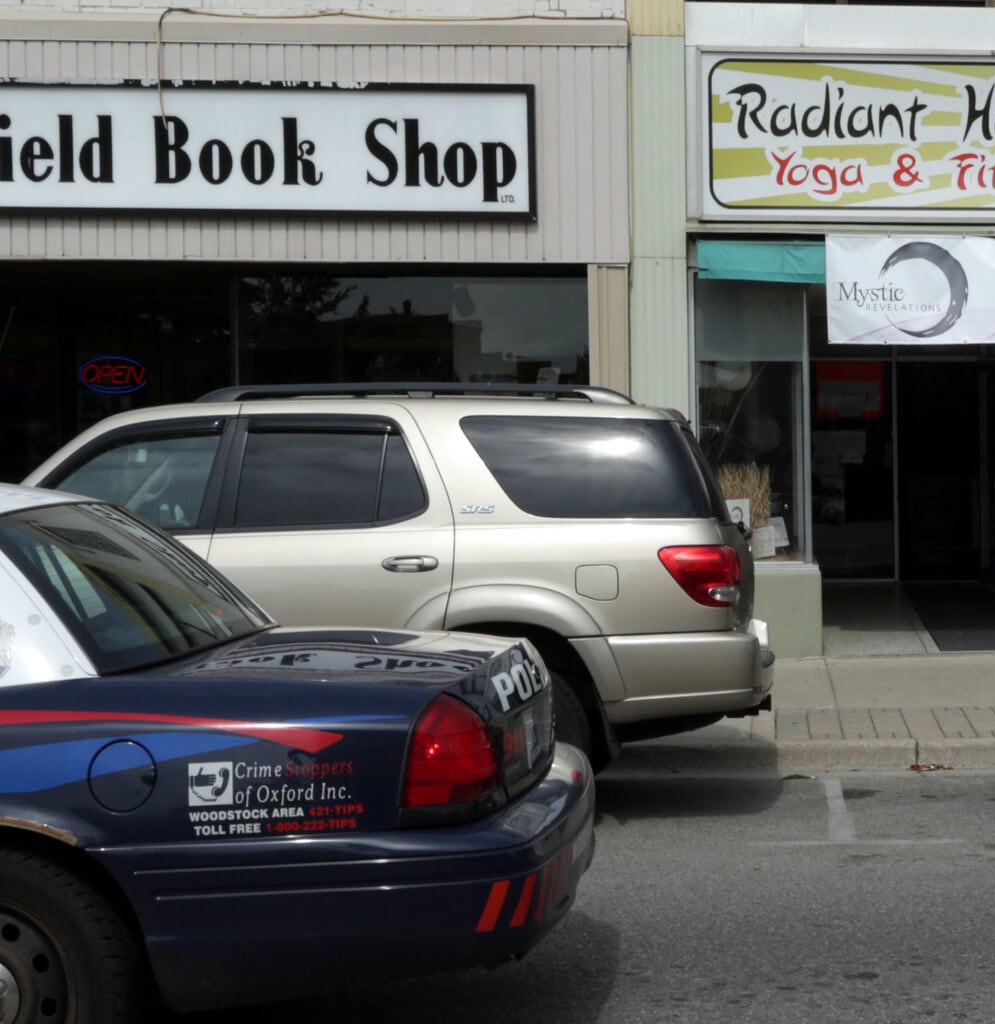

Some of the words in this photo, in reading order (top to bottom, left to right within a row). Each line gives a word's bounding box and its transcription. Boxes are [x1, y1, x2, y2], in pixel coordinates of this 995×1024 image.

[727, 84, 928, 140] Radiant
[152, 115, 324, 186] Book
[364, 117, 517, 203] Shop
[771, 150, 863, 195] Yoga
[892, 153, 924, 186] &
[838, 281, 904, 306] Mystic
[865, 302, 941, 313] REVELATIONS
[81, 363, 147, 386] OPEN
[234, 762, 283, 779] Crime
[286, 761, 354, 779] Stoppers
[235, 785, 253, 807] of
[257, 783, 315, 806] Oxford
[321, 783, 352, 801] Inc.
[189, 808, 269, 822] WOODSTOCK
[271, 807, 305, 819] AREA
[194, 824, 226, 836] TOLL
[229, 823, 262, 835] FREE
